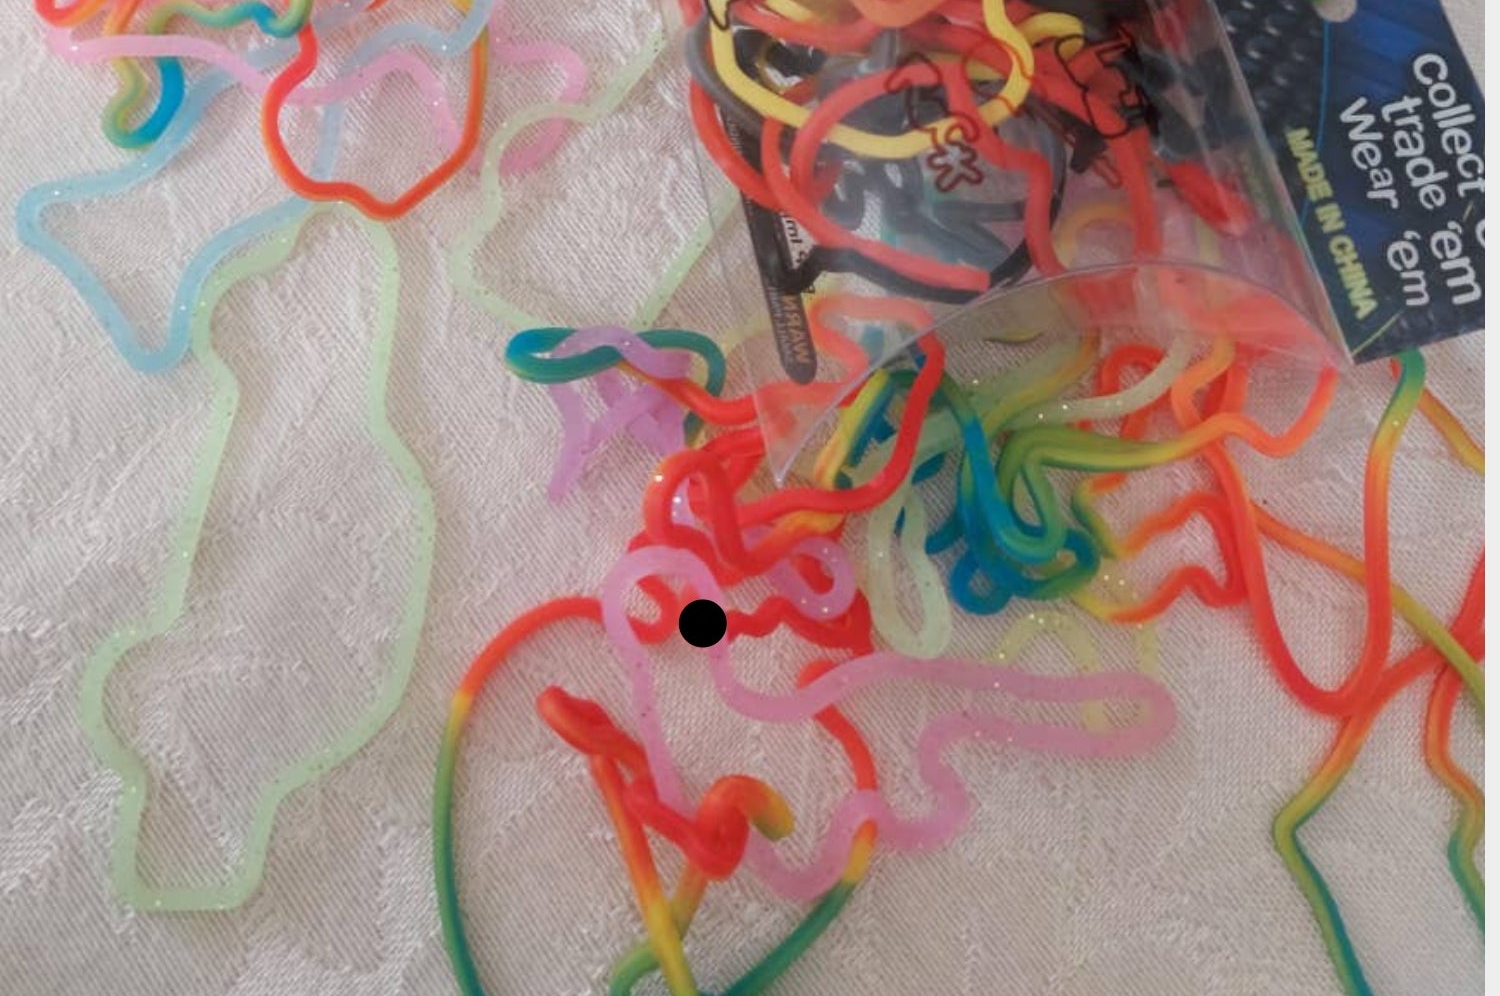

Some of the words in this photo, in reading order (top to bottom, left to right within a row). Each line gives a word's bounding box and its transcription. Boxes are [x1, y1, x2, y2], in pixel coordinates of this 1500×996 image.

[1285, 127, 1333, 201] MADE
[1340, 97, 1398, 209] Wear
[1382, 95, 1448, 209] trade
[1315, 203, 1346, 233] IN
[1328, 234, 1378, 321] CHINA
